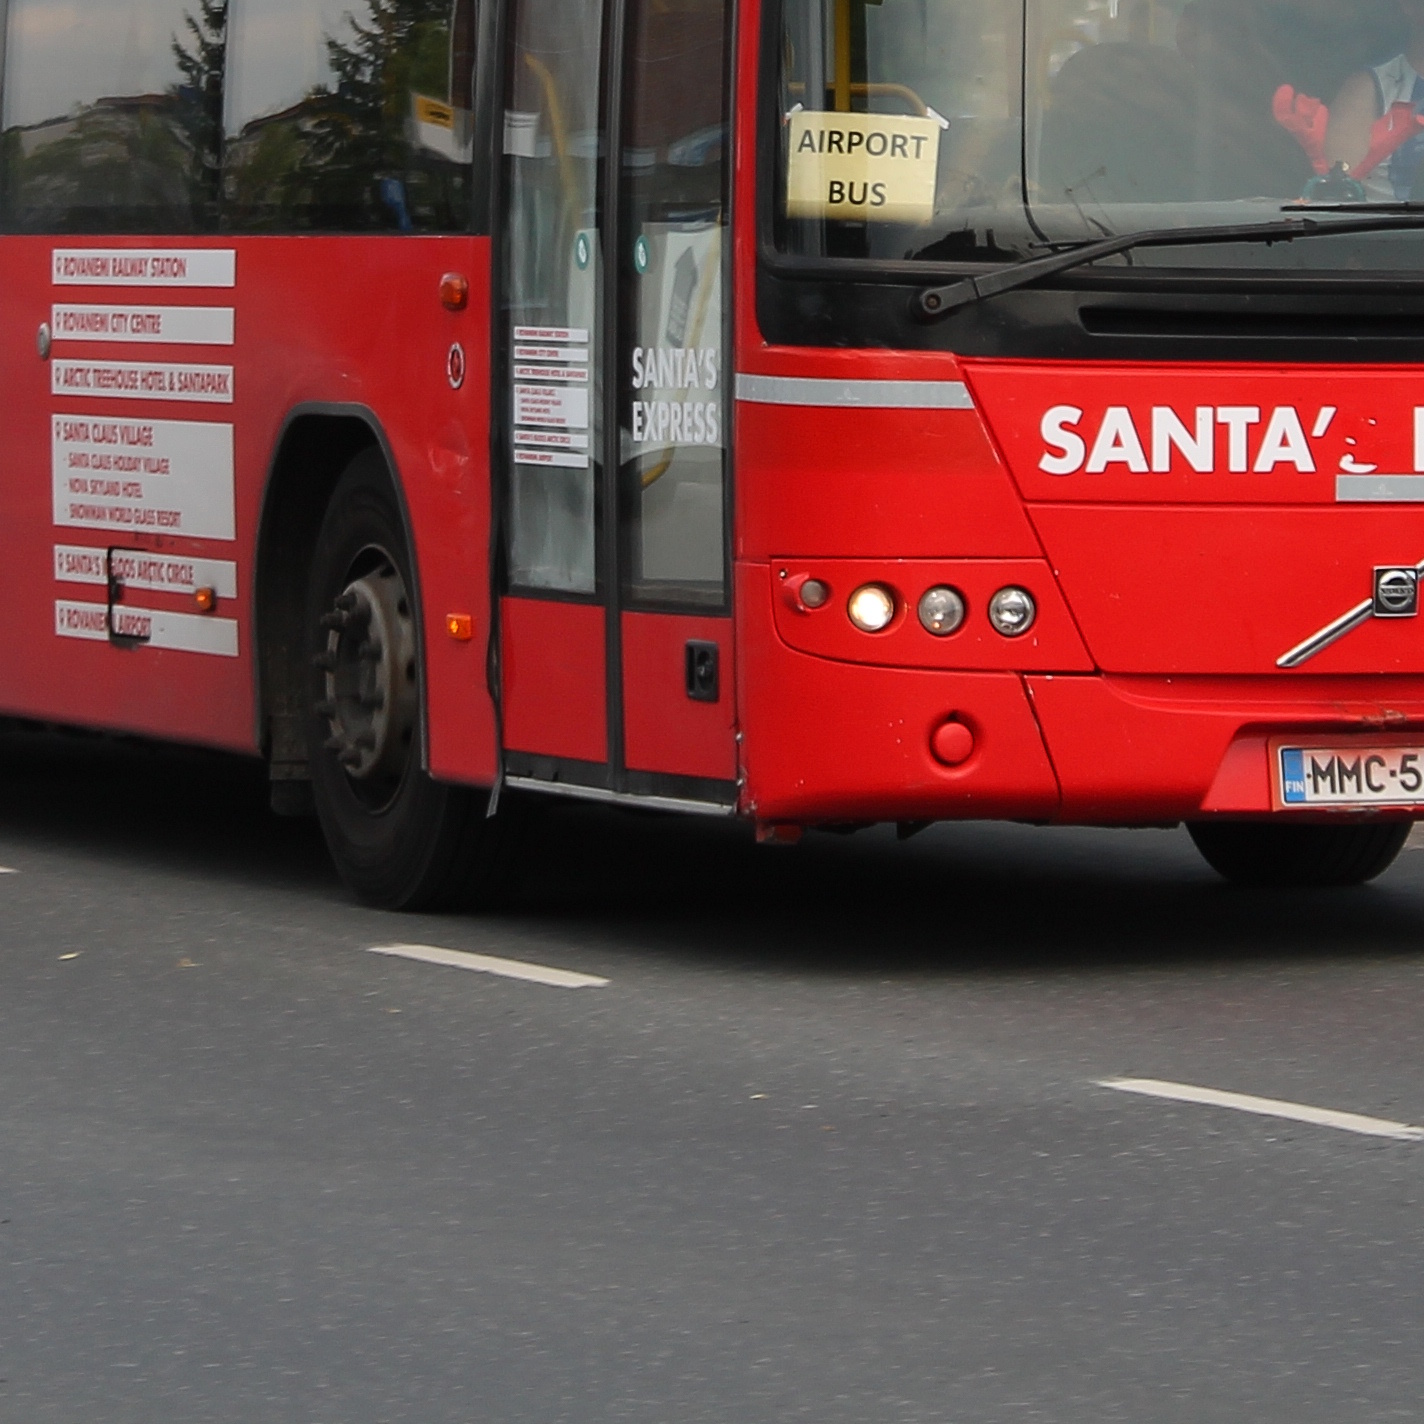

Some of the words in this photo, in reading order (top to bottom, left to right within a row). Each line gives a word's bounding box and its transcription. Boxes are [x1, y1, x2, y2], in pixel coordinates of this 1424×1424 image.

[798, 129, 929, 160] AIRPORT
[828, 180, 887, 207] BUS
[63, 257, 110, 277] ROVANIEMI
[111, 257, 148, 277] RAILWAY
[150, 257, 187, 278] STATION
[63, 312, 109, 332] ROVANIEMI
[111, 313, 128, 334] CITY
[131, 313, 161, 334] CENTRE
[63, 367, 91, 388] ARCTIC
[92, 368, 138, 390] TREEHOUSE
[140, 370, 167, 391] HOTEL
[178, 372, 229, 394] SANTAPARK
[632, 347, 718, 390] SANTA'S
[63, 421, 89, 443] SANTA
[92, 423, 118, 444] CLAUS
[120, 424, 153, 447] VILLAGE
[632, 401, 718, 444] EXPRESS
[1038, 405, 1378, 475] SANTA'
[65, 554, 101, 576] SANTA'S
[138, 559, 164, 583] ARCTIC
[166, 562, 194, 585] CIRCLE
[117, 614, 151, 636] AIRPORT
[1285, 780, 1305, 793] FIN
